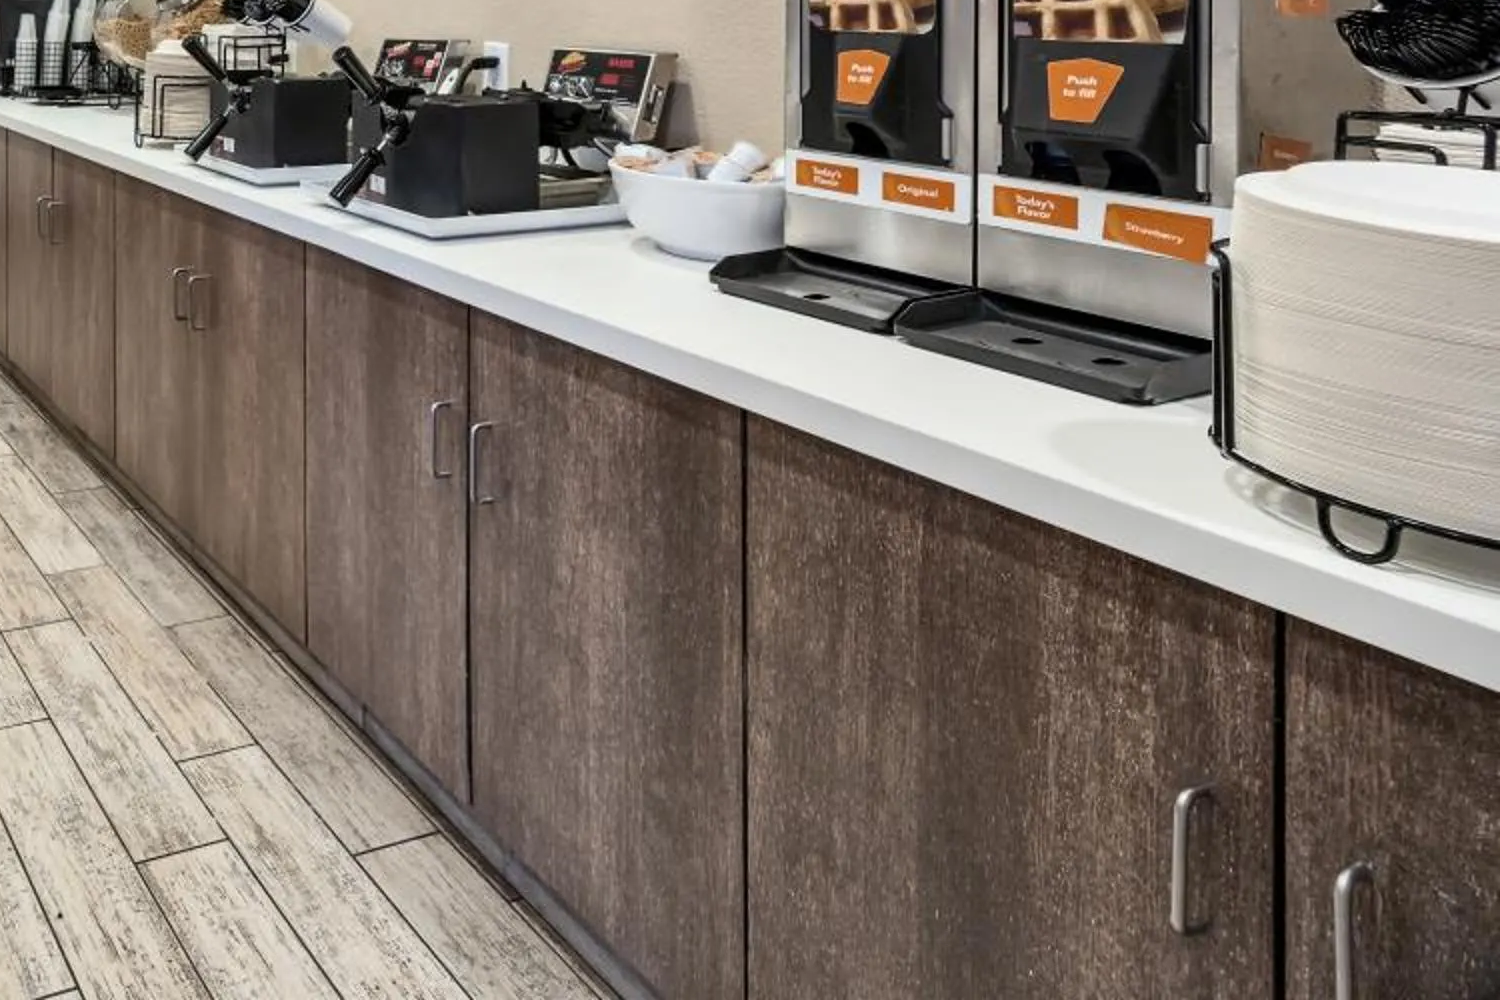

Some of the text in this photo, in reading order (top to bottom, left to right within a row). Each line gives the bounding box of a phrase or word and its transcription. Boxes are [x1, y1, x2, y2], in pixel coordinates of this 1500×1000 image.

[851, 63, 875, 75] Push
[1066, 74, 1098, 87] Push
[1063, 87, 1098, 100] to fill
[812, 165, 843, 180] Today's
[897, 183, 940, 199] Original
[1015, 194, 1056, 211] Today's
[1017, 205, 1052, 220] Flavor
[1124, 220, 1185, 245] Strawberry
